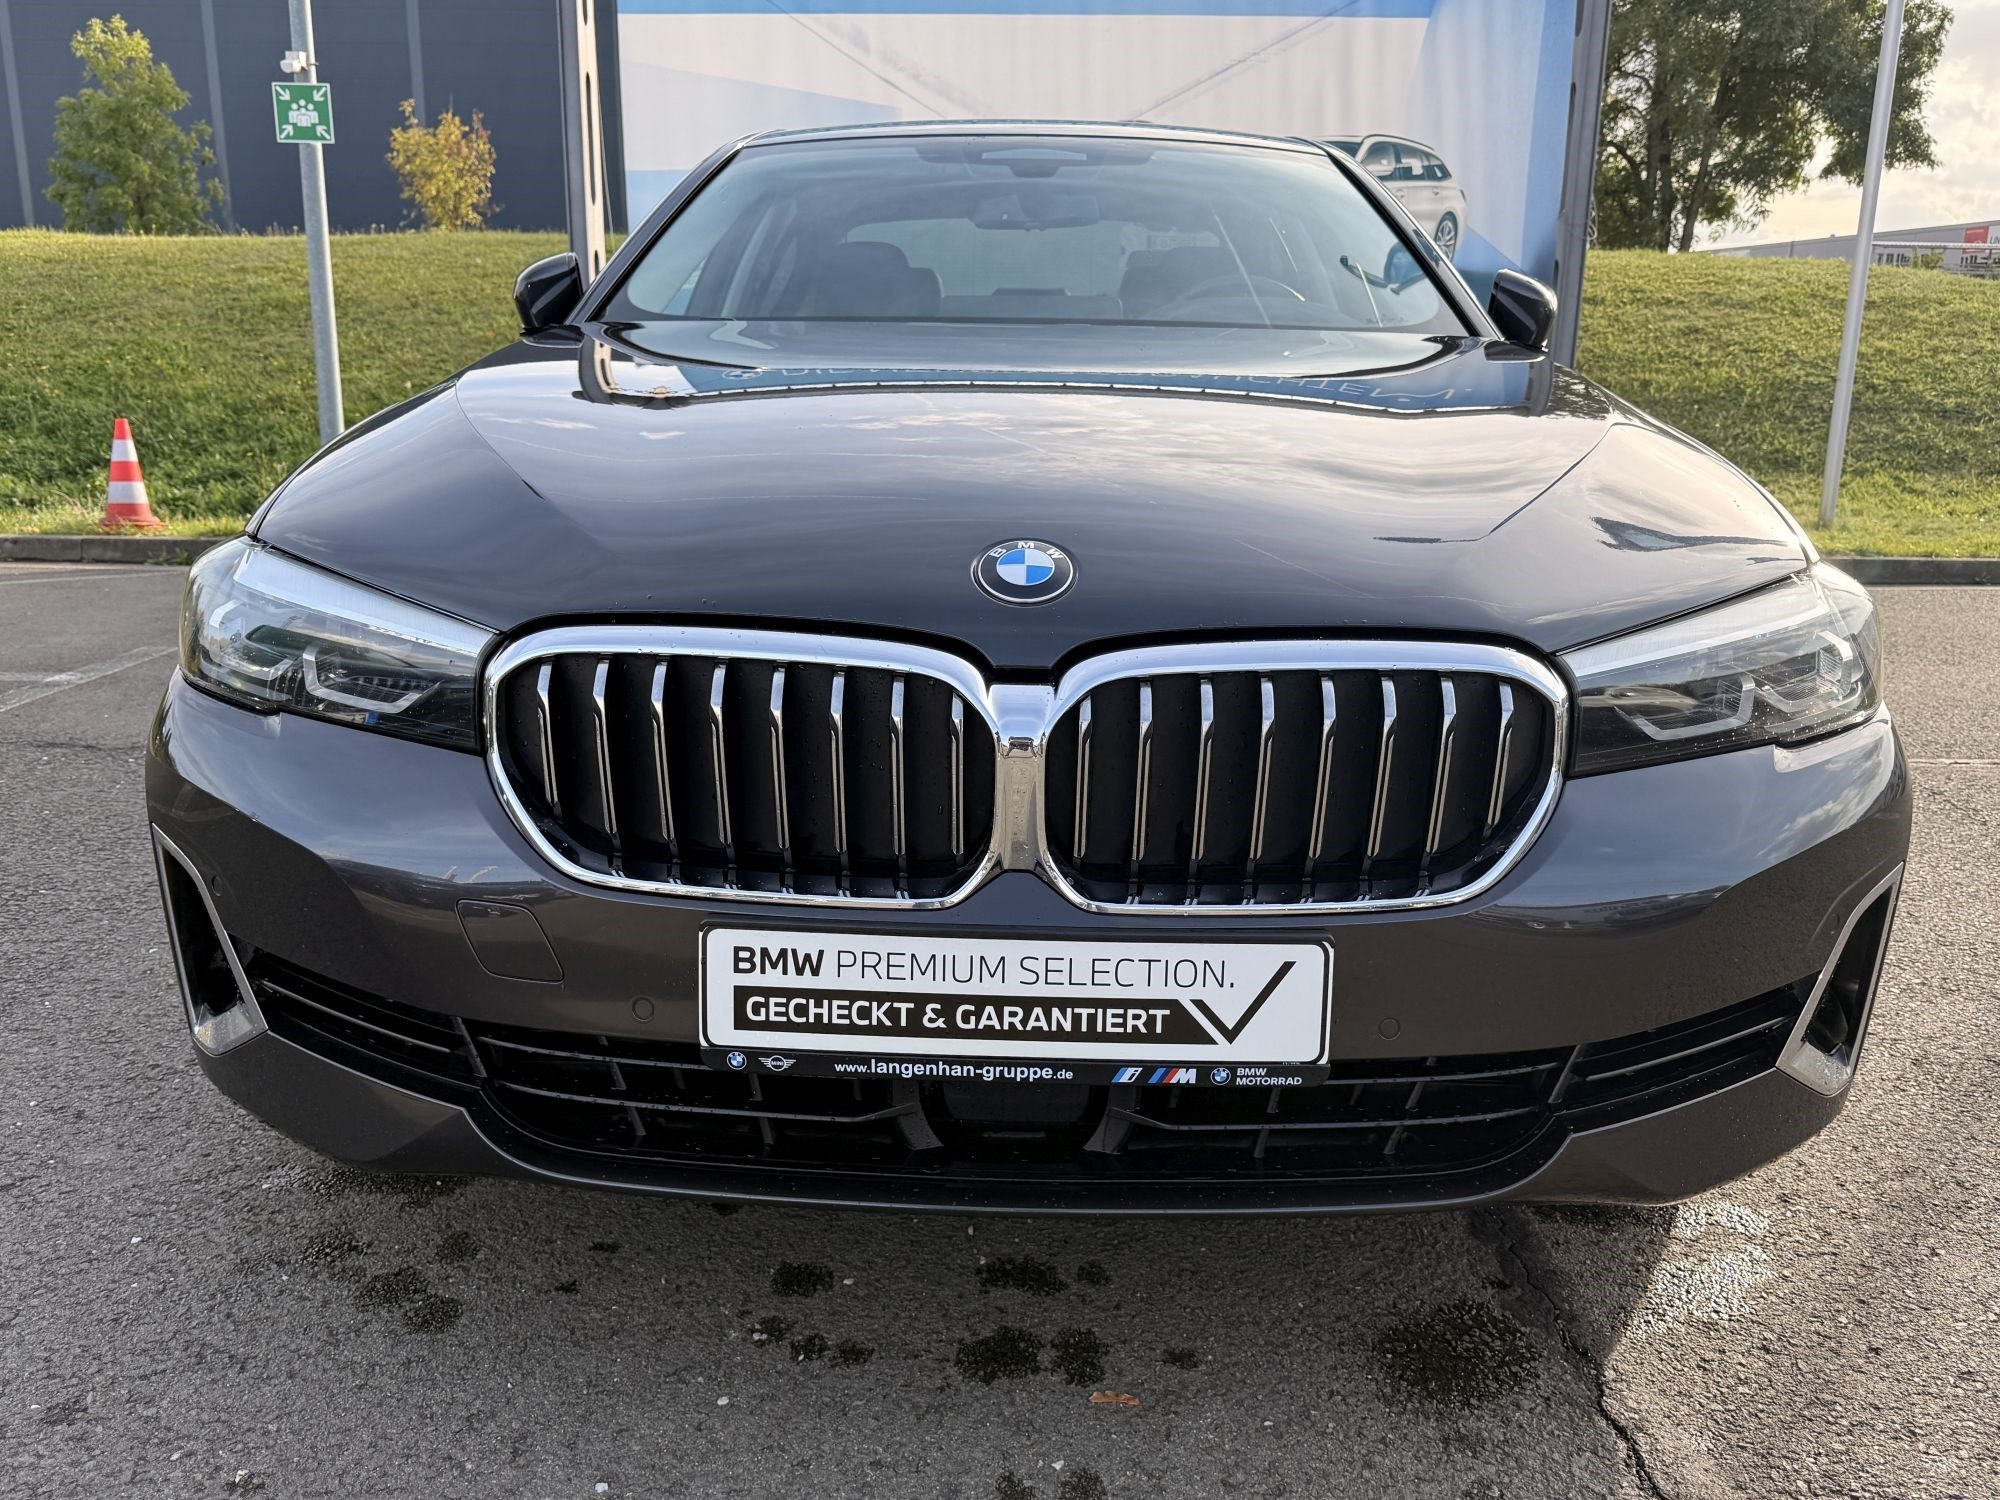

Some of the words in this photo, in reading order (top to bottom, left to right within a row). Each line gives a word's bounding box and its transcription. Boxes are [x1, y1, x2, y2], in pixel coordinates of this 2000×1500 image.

[989, 541, 1064, 559] BMW
[732, 945, 825, 977] BMW
[836, 950, 1006, 984] PREMIUM
[1019, 955, 1235, 989] SELECTION.
[745, 995, 915, 1027] GECHECKT
[922, 1003, 947, 1028] &
[955, 1003, 1171, 1034] GARANTIERT
[834, 1058, 1073, 1082] www.langenhan-gruppe.de
[1236, 1067, 1268, 1076] BMW
[1235, 1077, 1303, 1086] MOTORRAD
